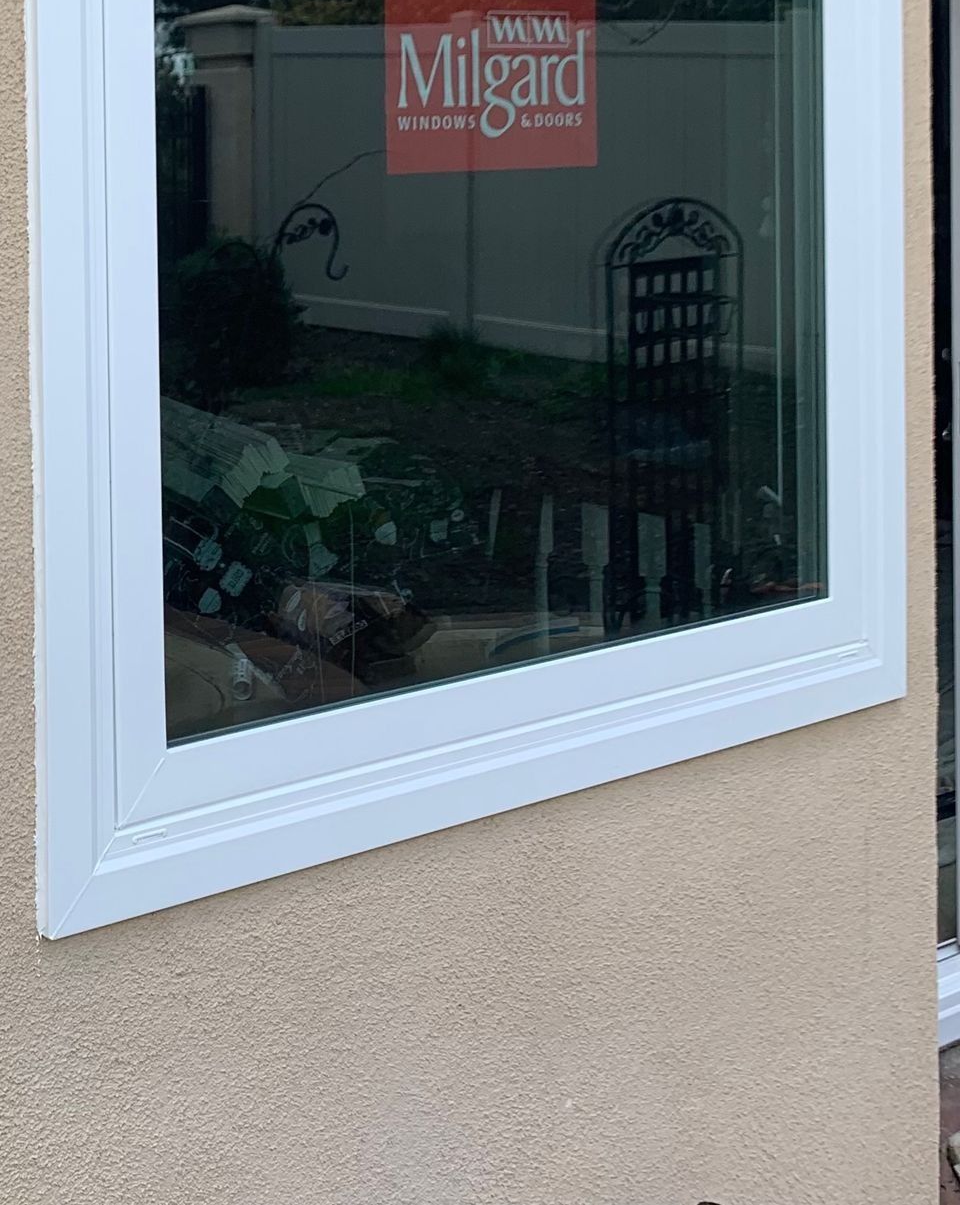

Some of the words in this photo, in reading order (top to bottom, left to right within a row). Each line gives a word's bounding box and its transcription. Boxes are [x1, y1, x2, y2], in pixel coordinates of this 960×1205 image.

[397, 27, 586, 138] Milgard
[397, 114, 476, 131] WINDOWS
[520, 113, 532, 128] &
[534, 111, 584, 127] DOORS
